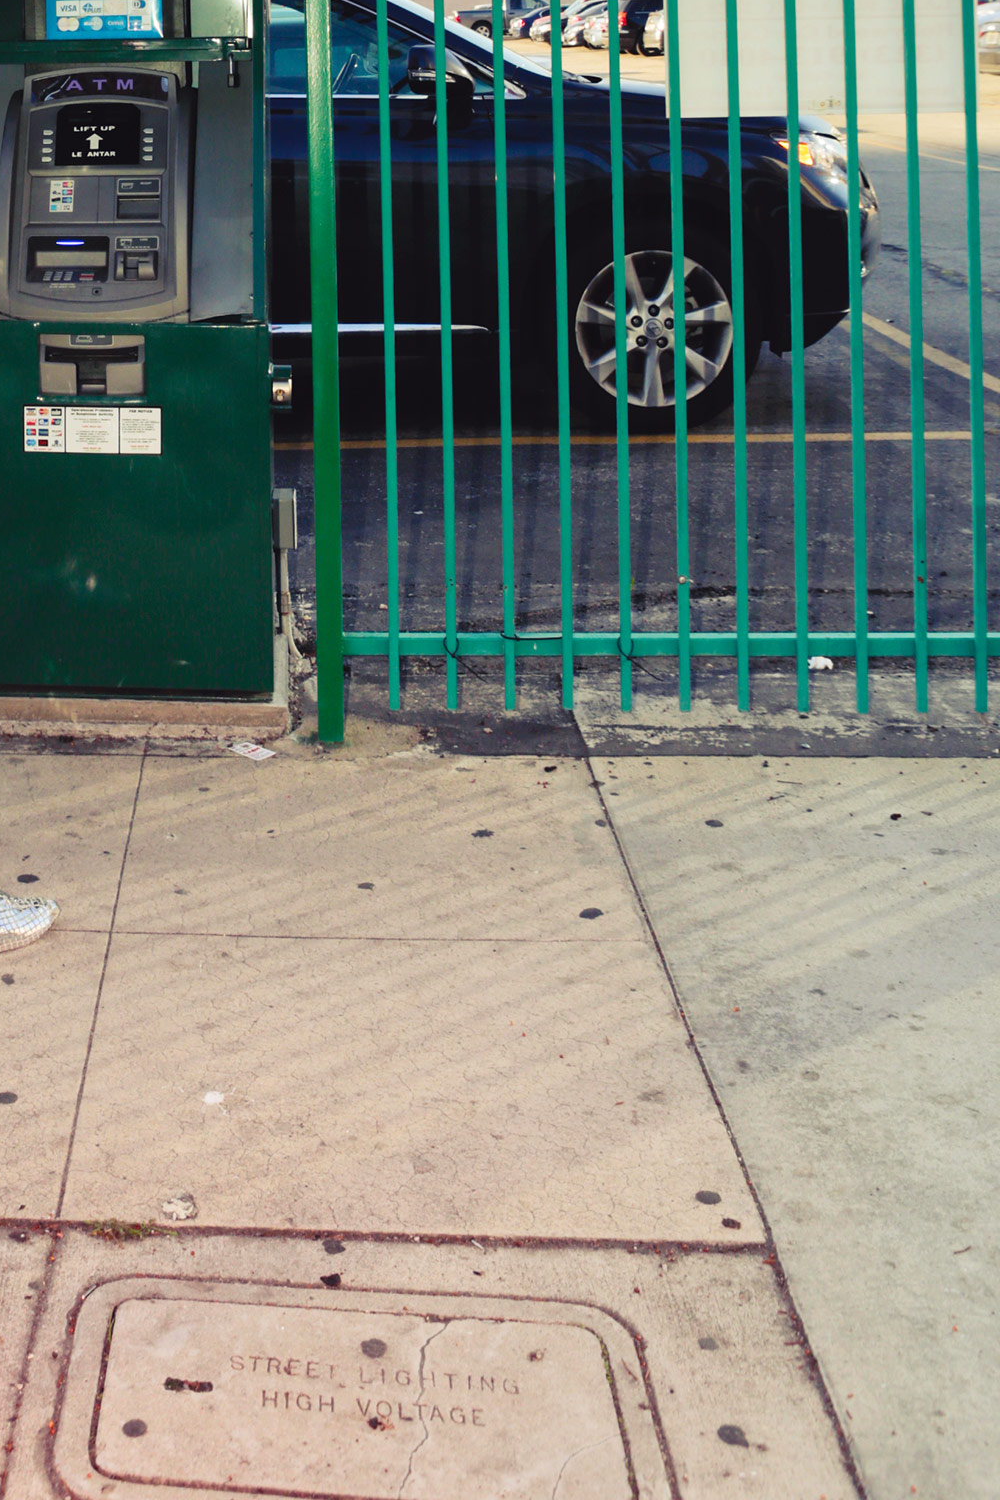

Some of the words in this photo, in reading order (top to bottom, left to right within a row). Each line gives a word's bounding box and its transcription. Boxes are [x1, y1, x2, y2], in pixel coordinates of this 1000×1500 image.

[66, 79, 134, 91] ATM
[229, 1355, 336, 1380] STREET
[358, 1366, 521, 1395] LIGHTING
[261, 1389, 335, 1414] HIGH
[355, 1398, 487, 1427] VOLTAGE
